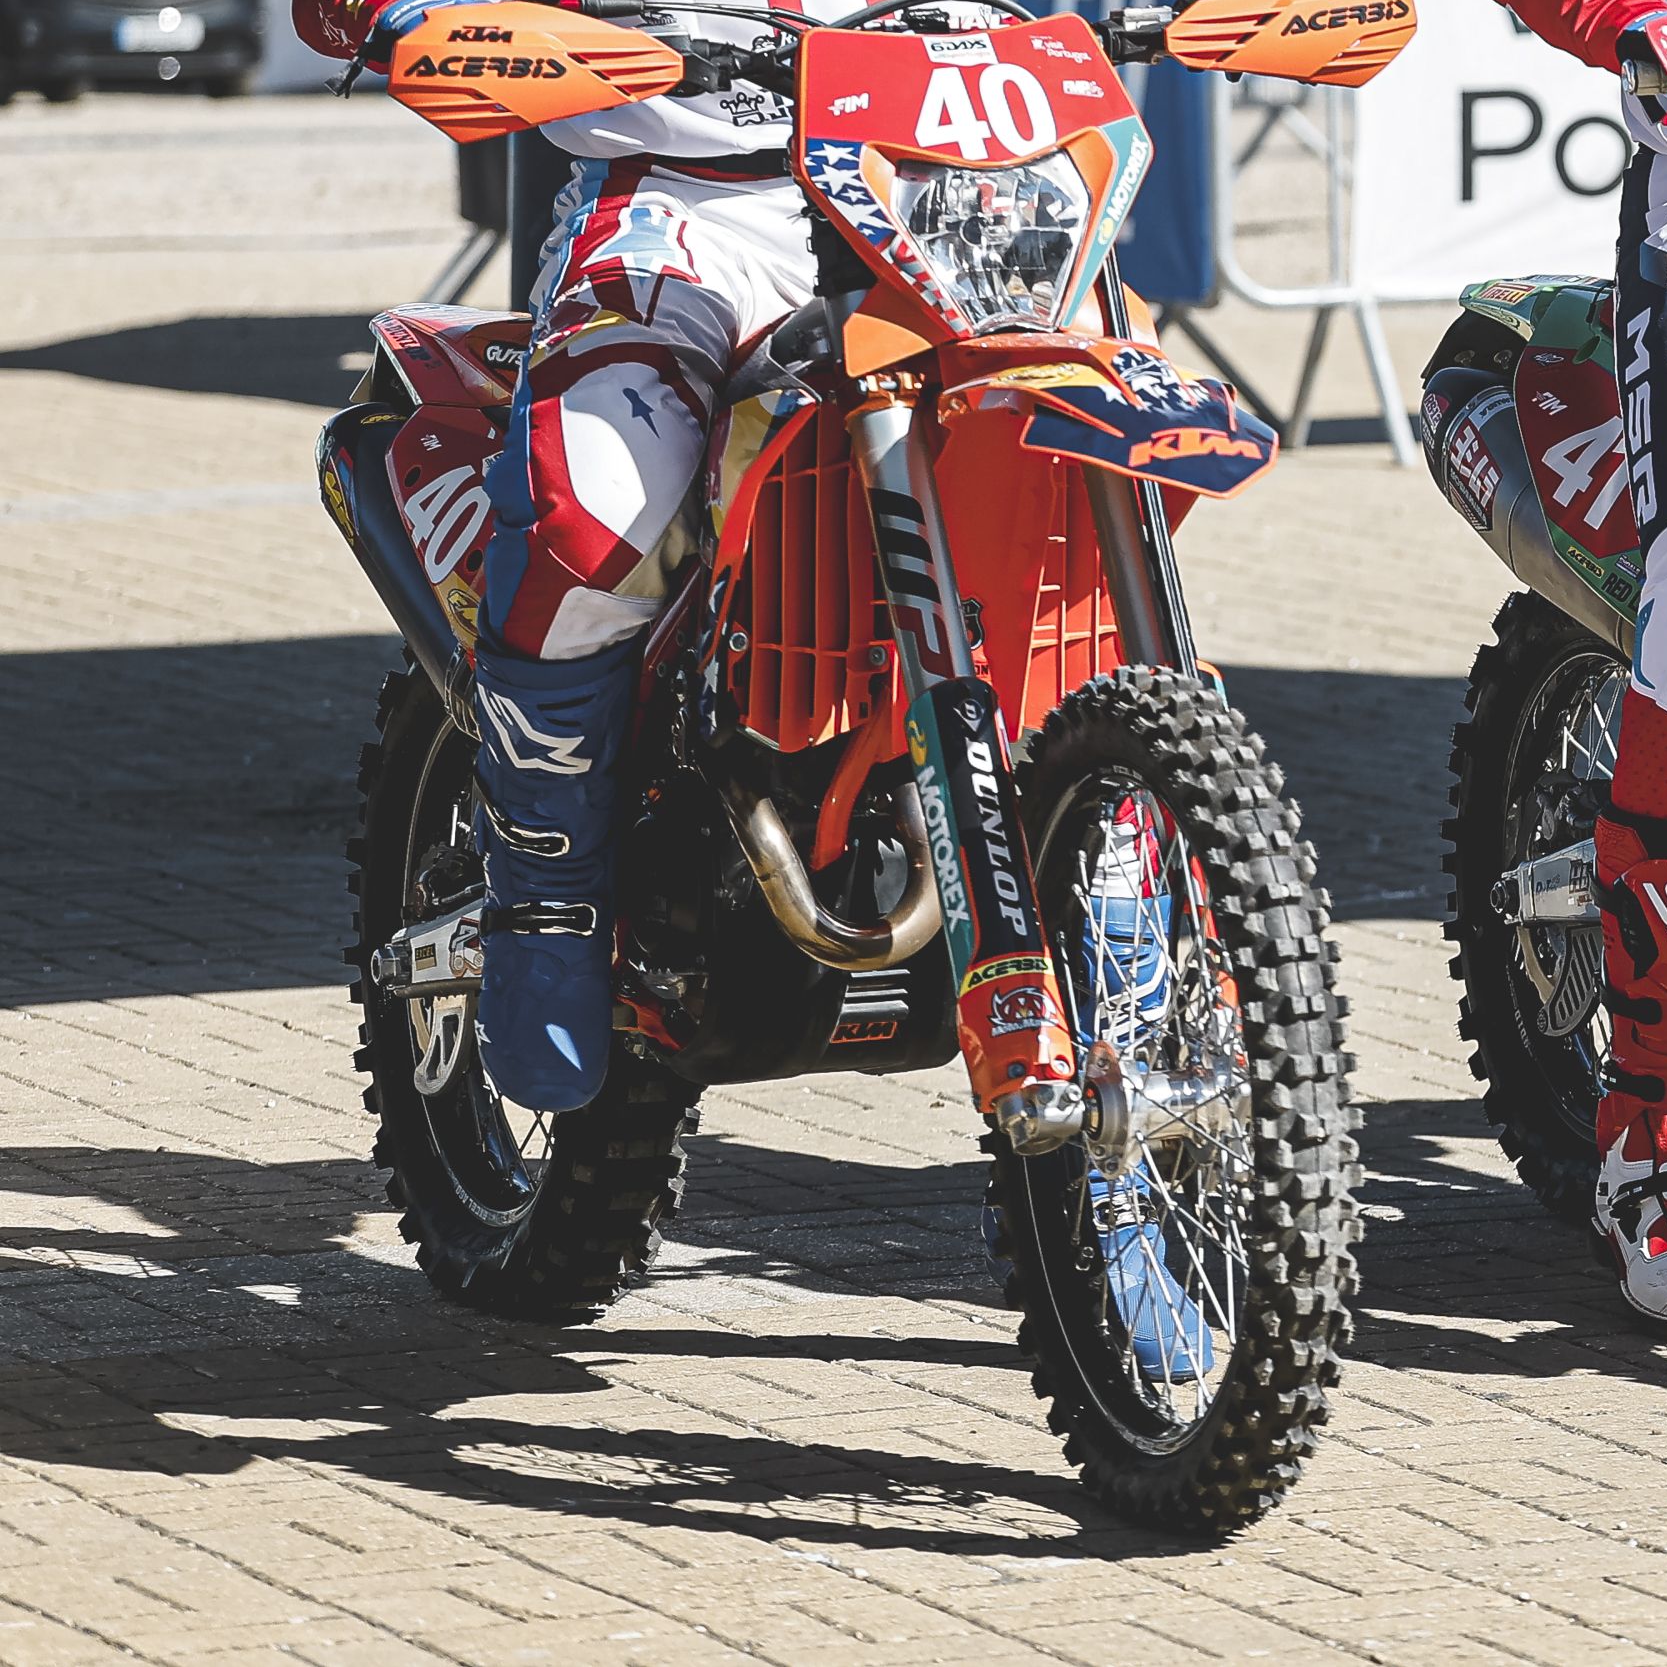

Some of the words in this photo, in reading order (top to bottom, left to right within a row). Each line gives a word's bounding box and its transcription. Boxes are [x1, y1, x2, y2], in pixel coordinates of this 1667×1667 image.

[404, 54, 567, 79] ACERBIS
[447, 24, 514, 43] KTM
[828, 93, 870, 116] FIM
[914, 63, 1057, 160] 40
[1462, 90, 1633, 201] Po
[1105, 133, 1150, 230] MOTOREX
[1127, 426, 1263, 467] KTM
[1625, 306, 1658, 522] MSR
[1542, 414, 1630, 530] 41
[404, 464, 492, 584] 40
[1601, 573, 1633, 602] RED
[914, 765, 969, 930] MOTOREX
[966, 736, 1030, 937] DUNLOP
[968, 957, 1048, 989] ACERBIS
